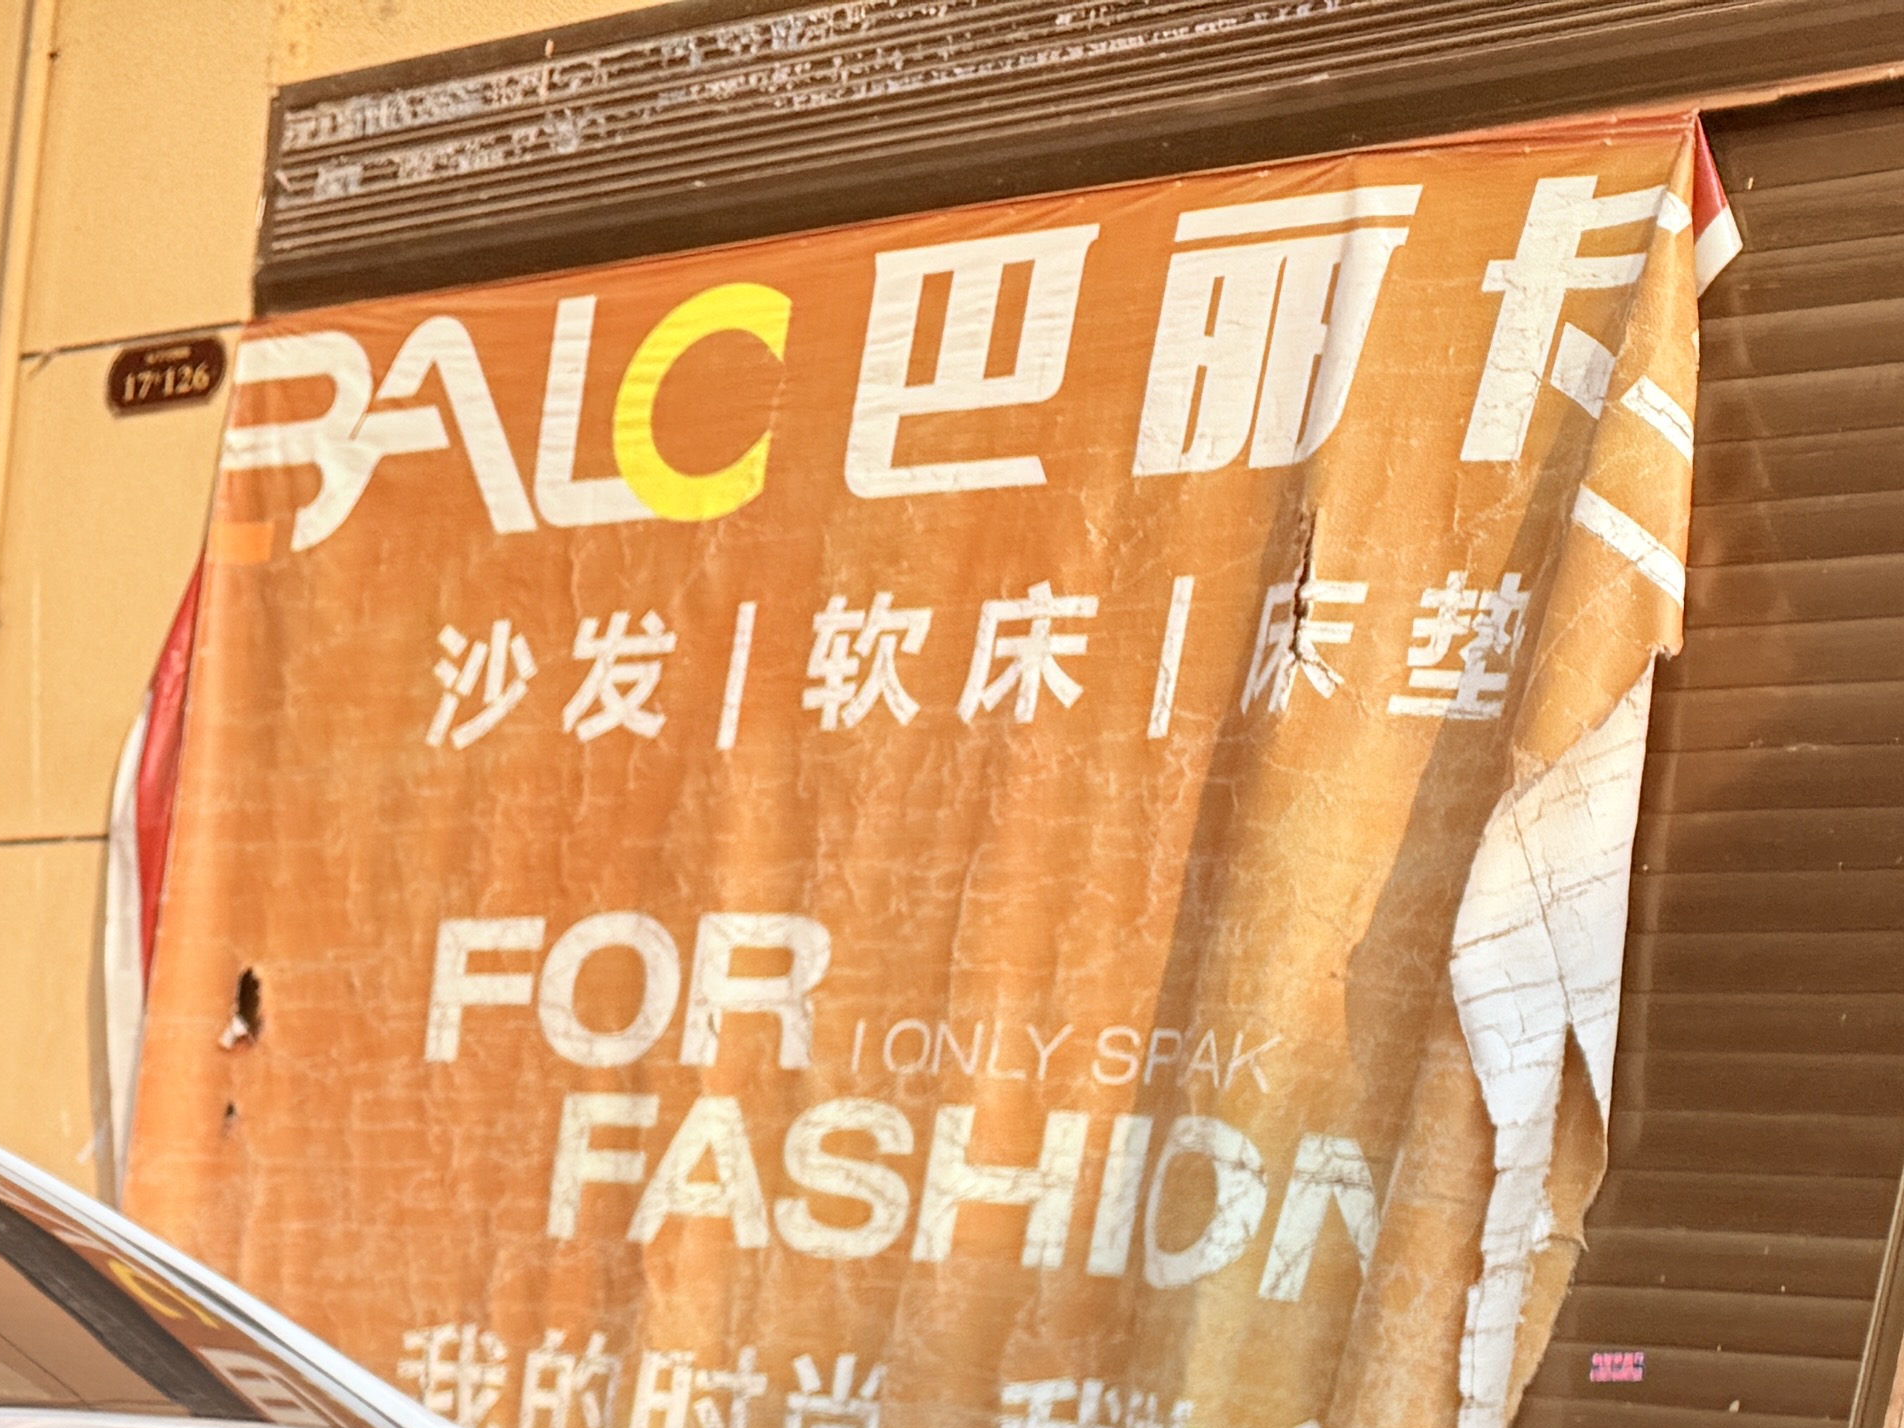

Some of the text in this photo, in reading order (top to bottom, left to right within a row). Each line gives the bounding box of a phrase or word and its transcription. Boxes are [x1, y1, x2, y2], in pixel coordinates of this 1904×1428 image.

[423, 910, 832, 1071] FOR
[850, 1018, 1284, 1096] I ONLY SPAK
